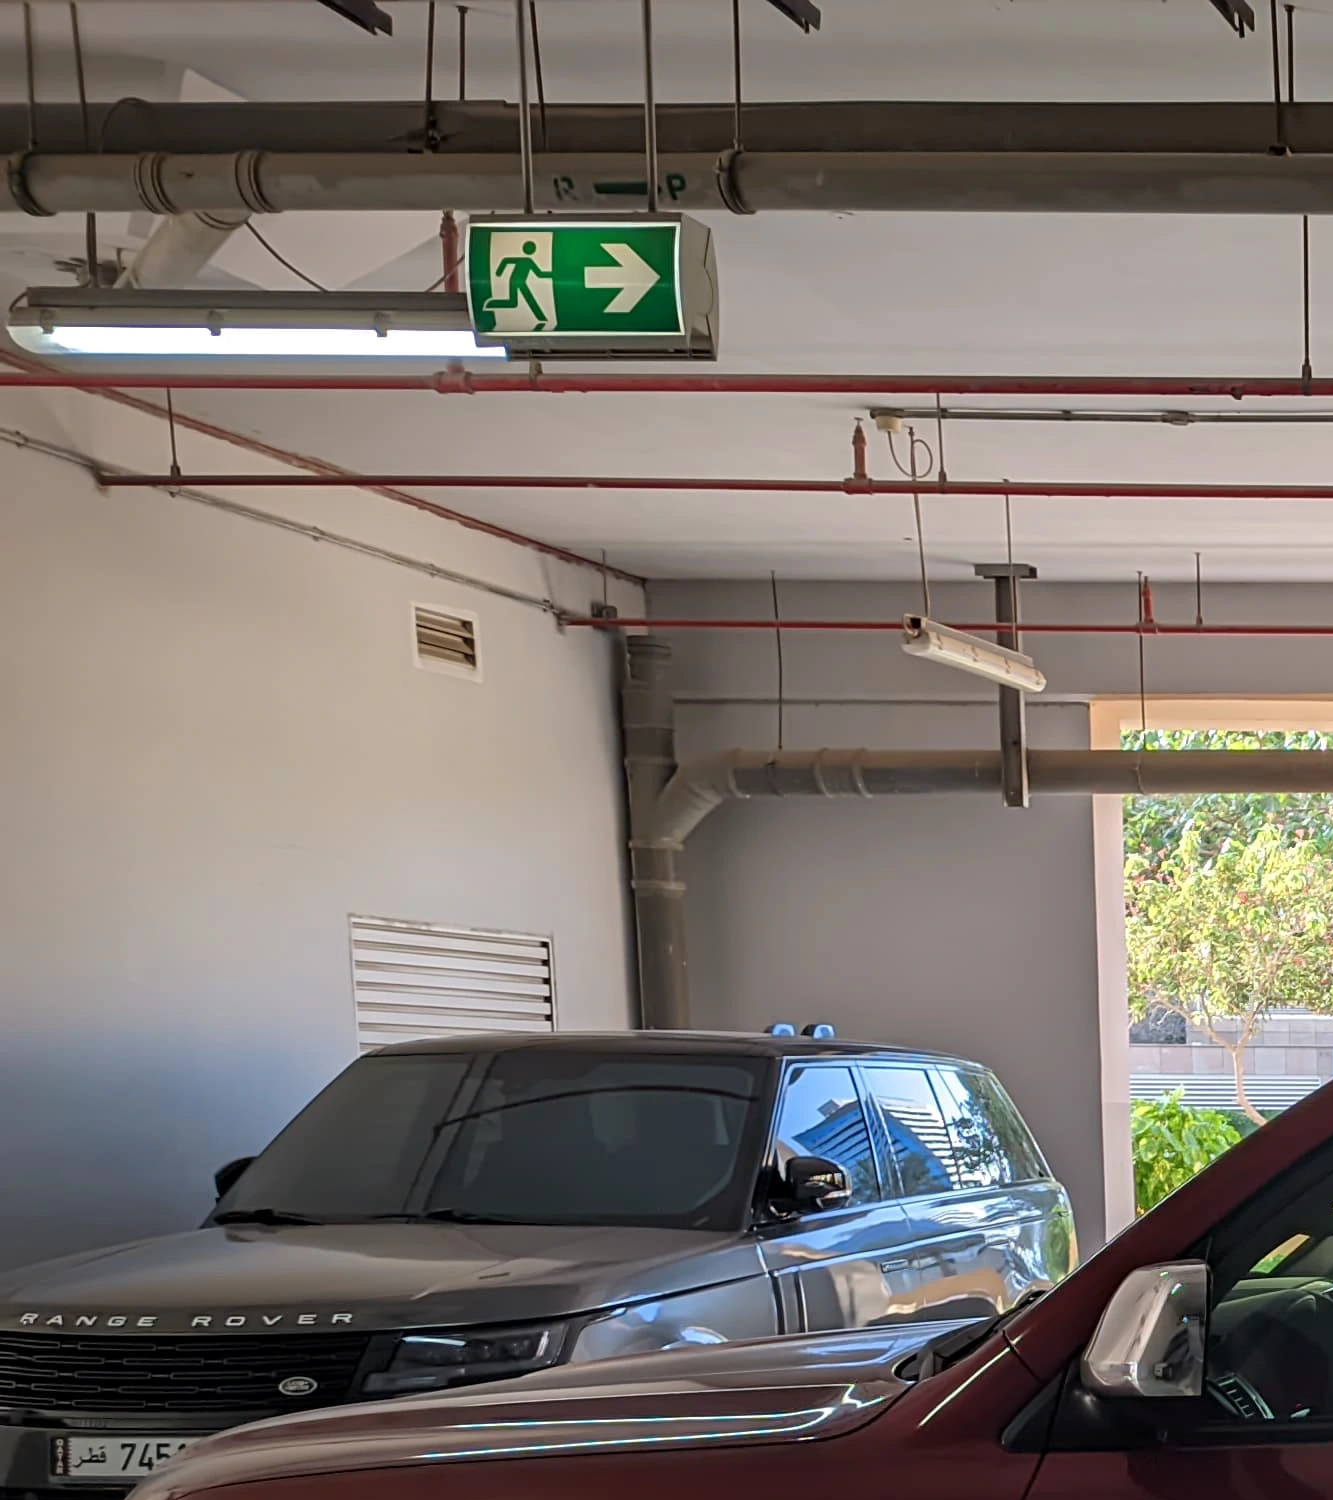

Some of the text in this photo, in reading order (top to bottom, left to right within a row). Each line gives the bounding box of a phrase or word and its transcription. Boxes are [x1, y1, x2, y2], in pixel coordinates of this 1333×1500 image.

[665, 173, 687, 201] P
[19, 1312, 354, 1327] RANGE ROVER
[73, 1446, 107, 1468] قطر
[120, 1443, 187, 1471] 745
